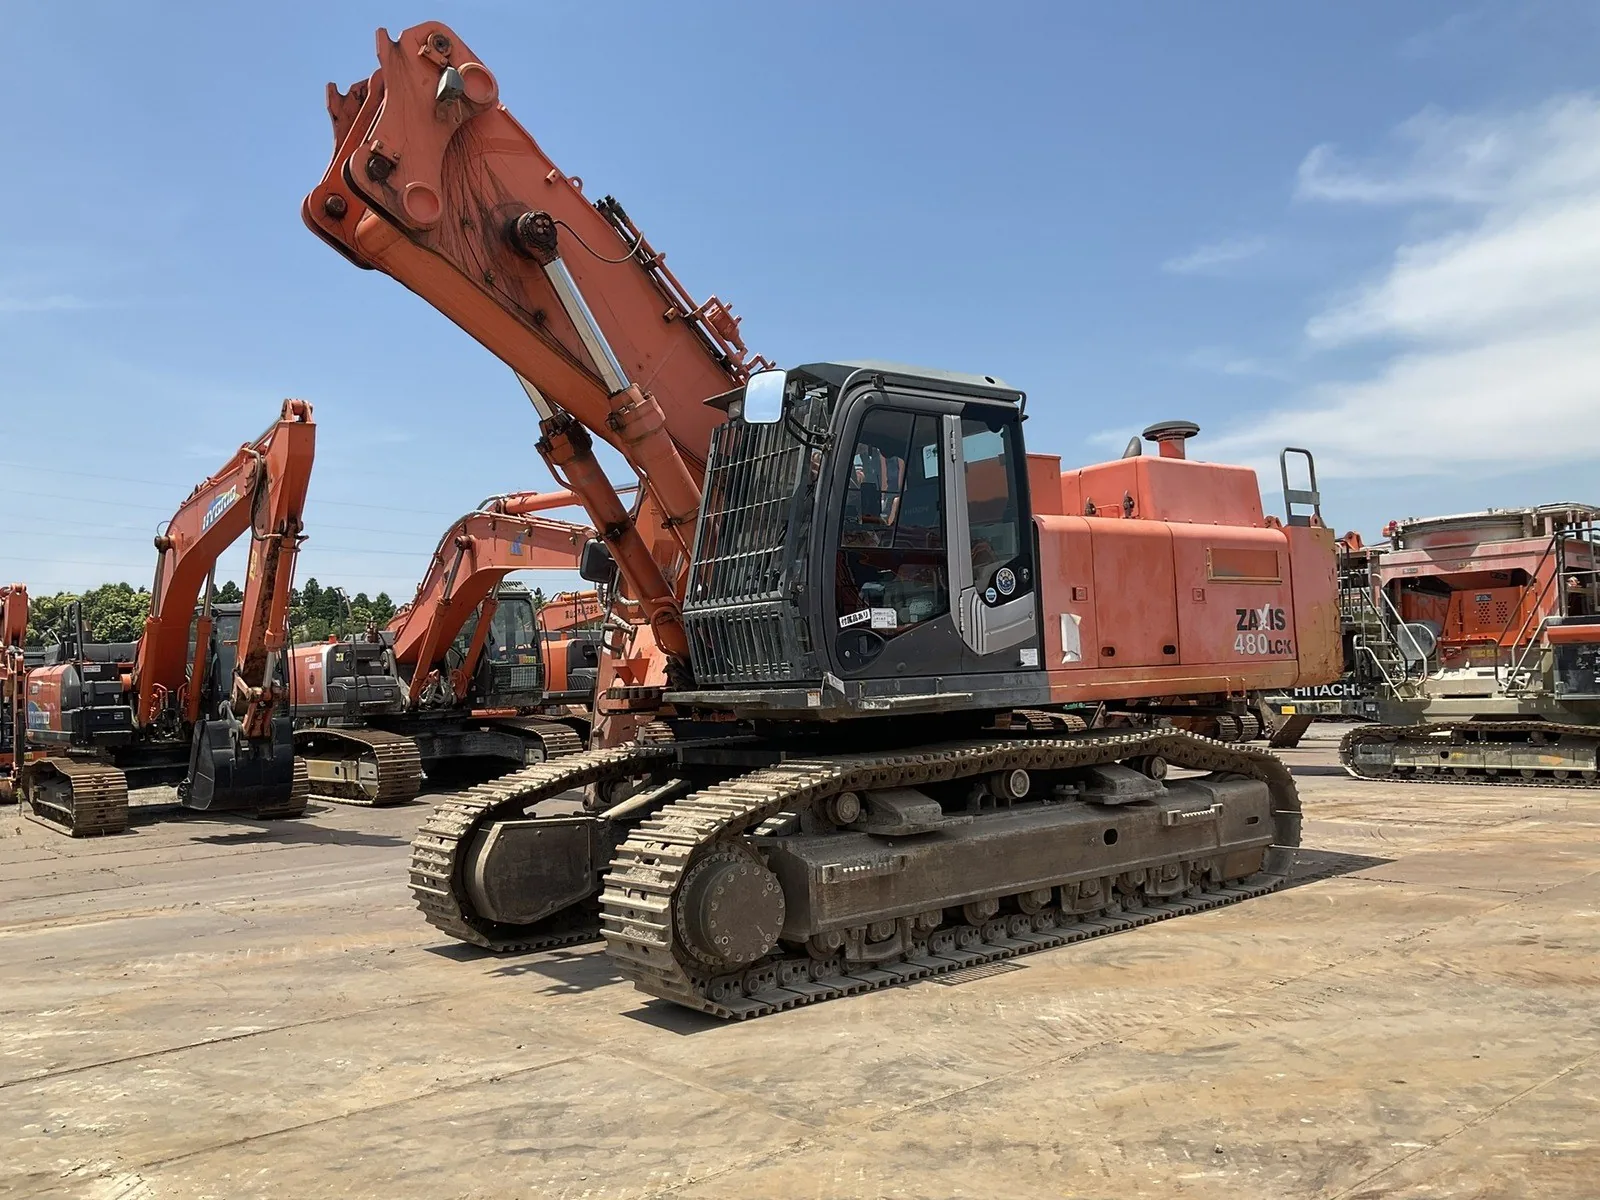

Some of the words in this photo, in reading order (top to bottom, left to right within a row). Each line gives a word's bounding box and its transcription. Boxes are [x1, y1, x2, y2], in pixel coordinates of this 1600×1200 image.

[202, 484, 237, 531] HYBRID
[841, 610, 869, 626] 付属品あり
[1235, 603, 1286, 631] ZAXIS
[1234, 633, 1293, 655] 480LCK
